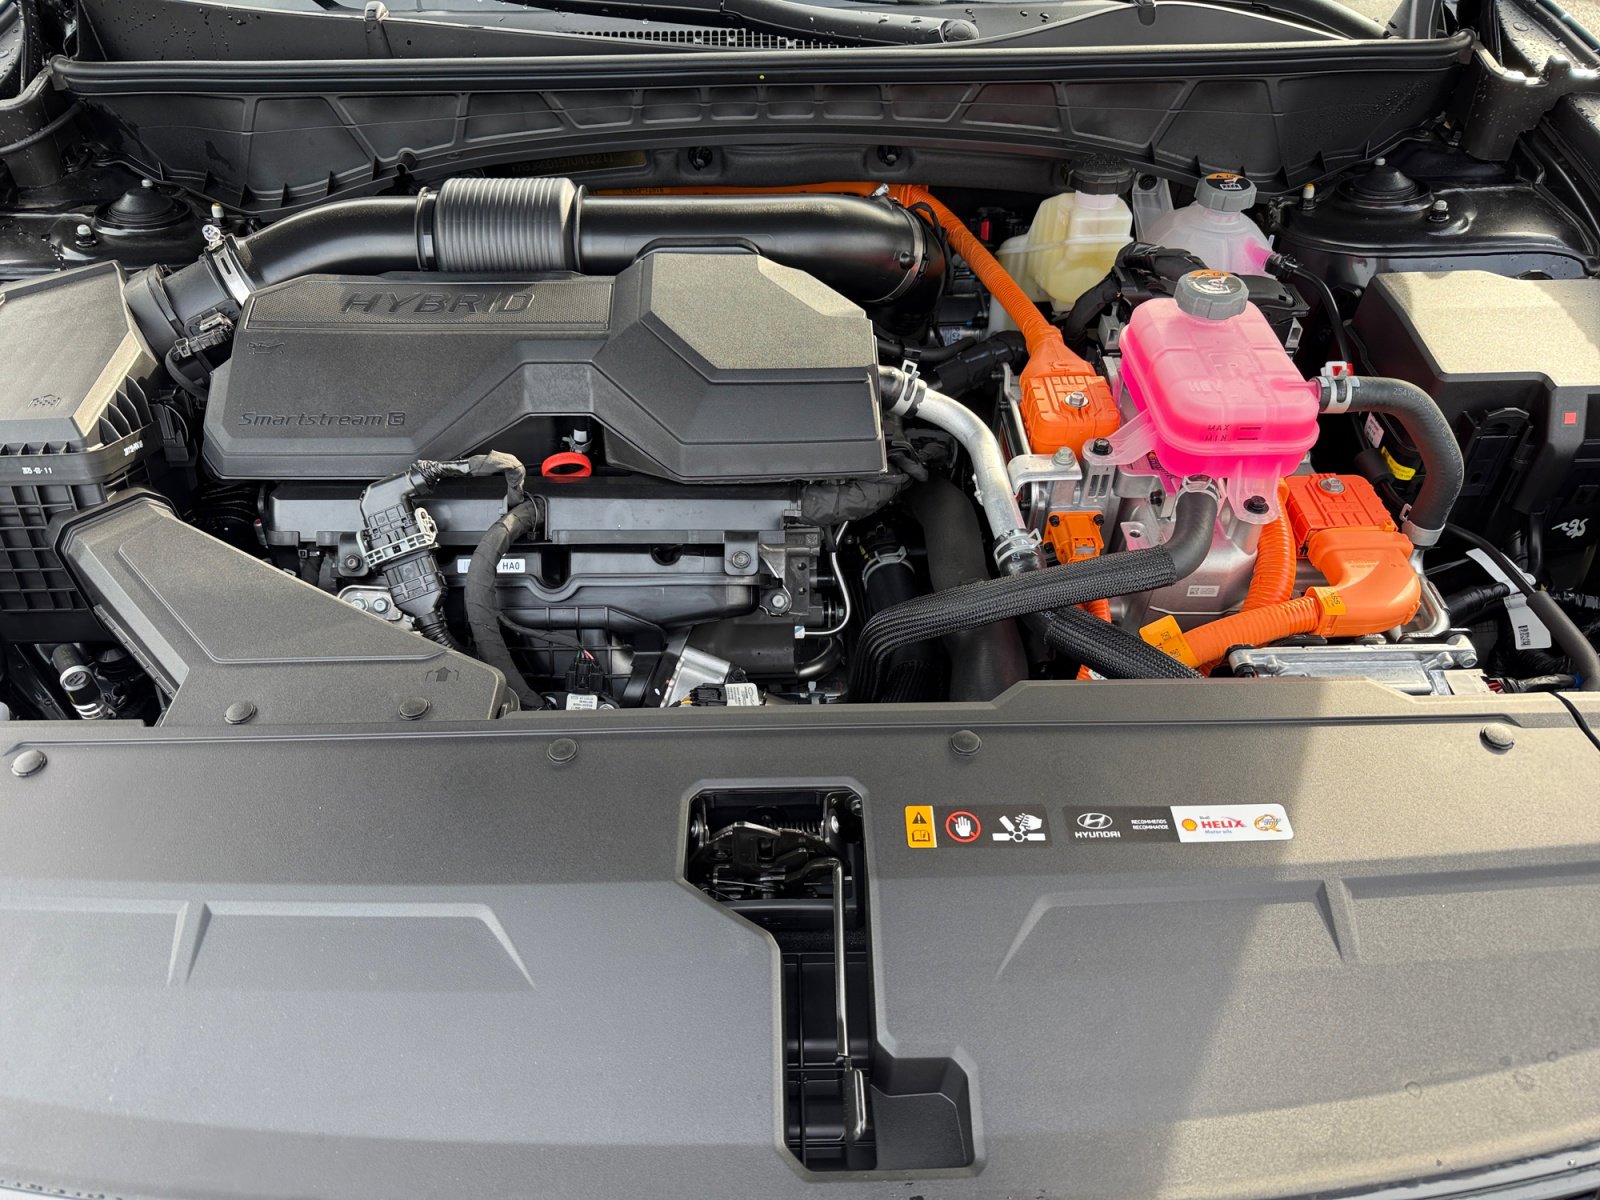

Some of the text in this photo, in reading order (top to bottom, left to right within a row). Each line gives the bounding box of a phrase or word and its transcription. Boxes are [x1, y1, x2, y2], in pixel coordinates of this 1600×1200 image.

[340, 292, 535, 313] HYBRID
[238, 411, 383, 426] Smartstream
[1201, 820, 1246, 829] HELIX
[1075, 831, 1121, 839] HYUNDAI
